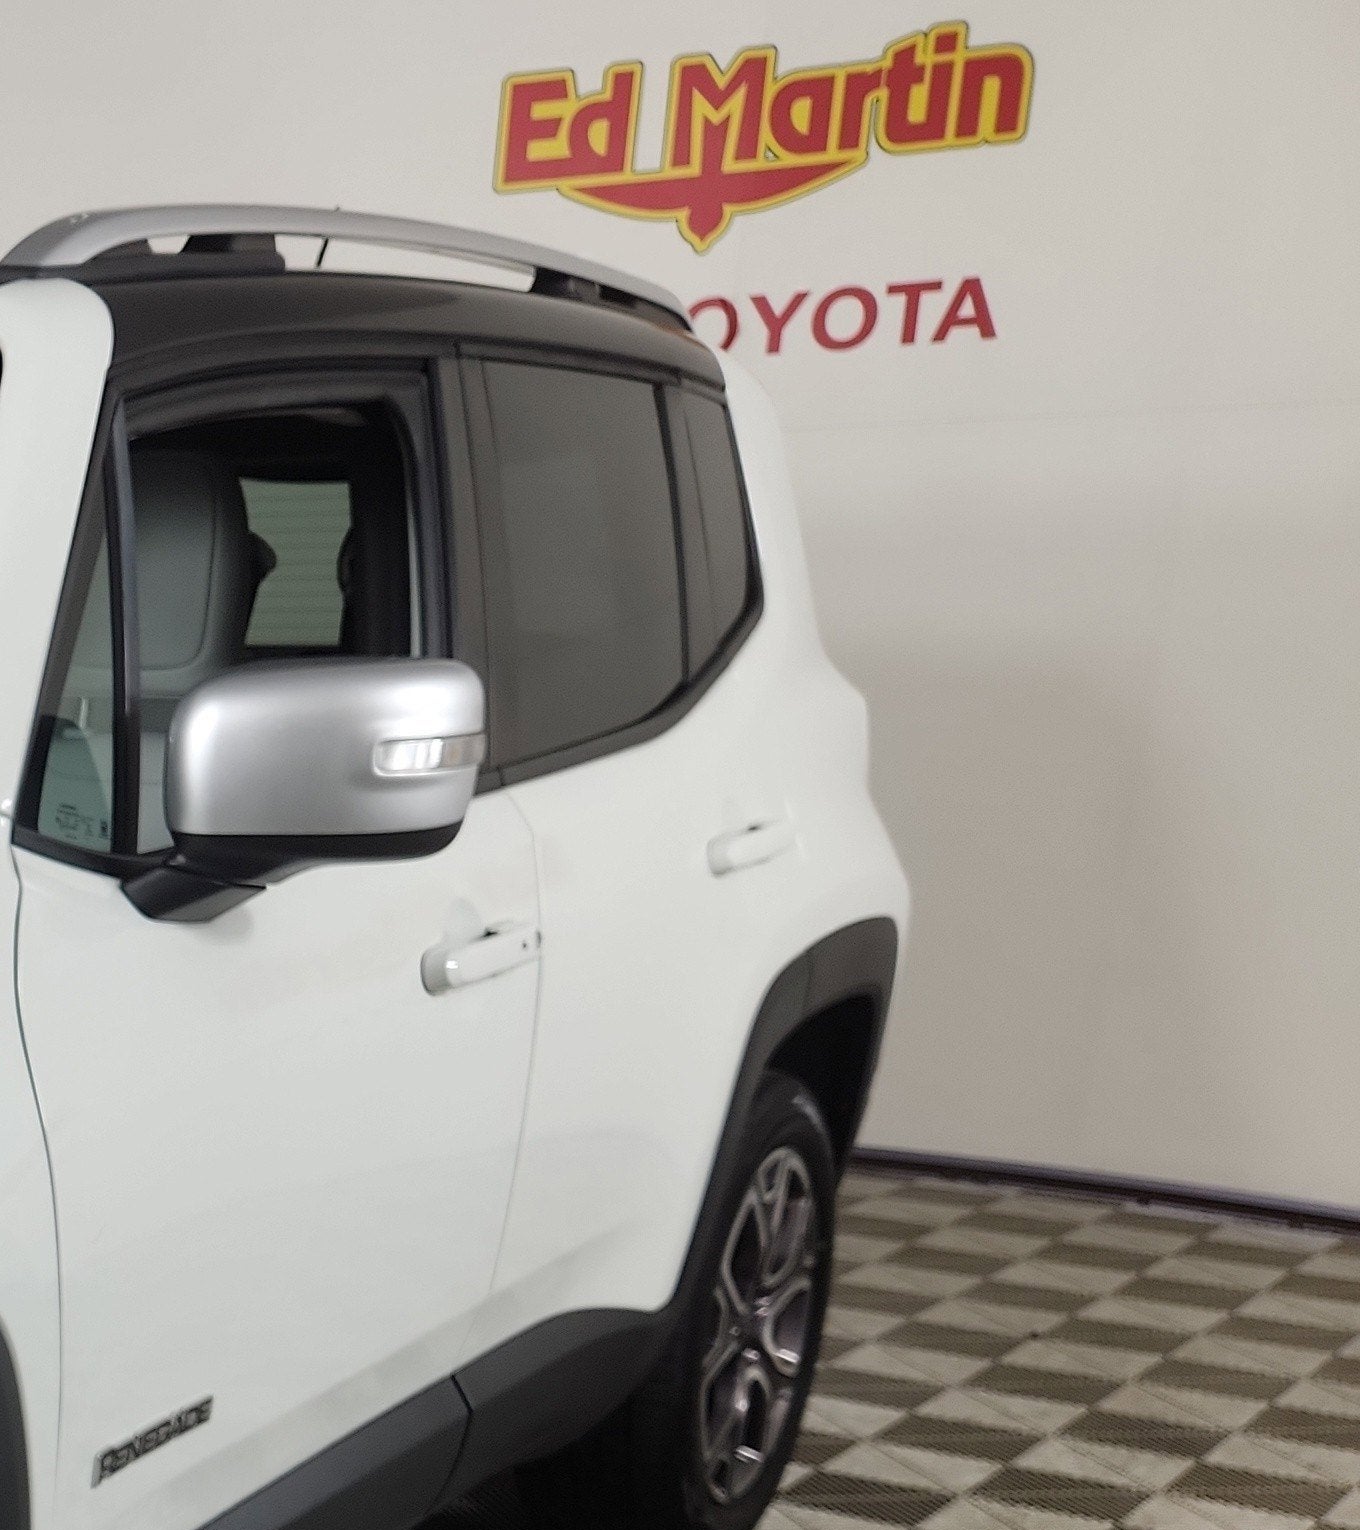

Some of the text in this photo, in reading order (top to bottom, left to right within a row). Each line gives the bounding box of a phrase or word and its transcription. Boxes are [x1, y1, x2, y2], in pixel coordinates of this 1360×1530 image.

[497, 22, 1033, 190] Ed Martin
[688, 277, 996, 355] OYOTA
